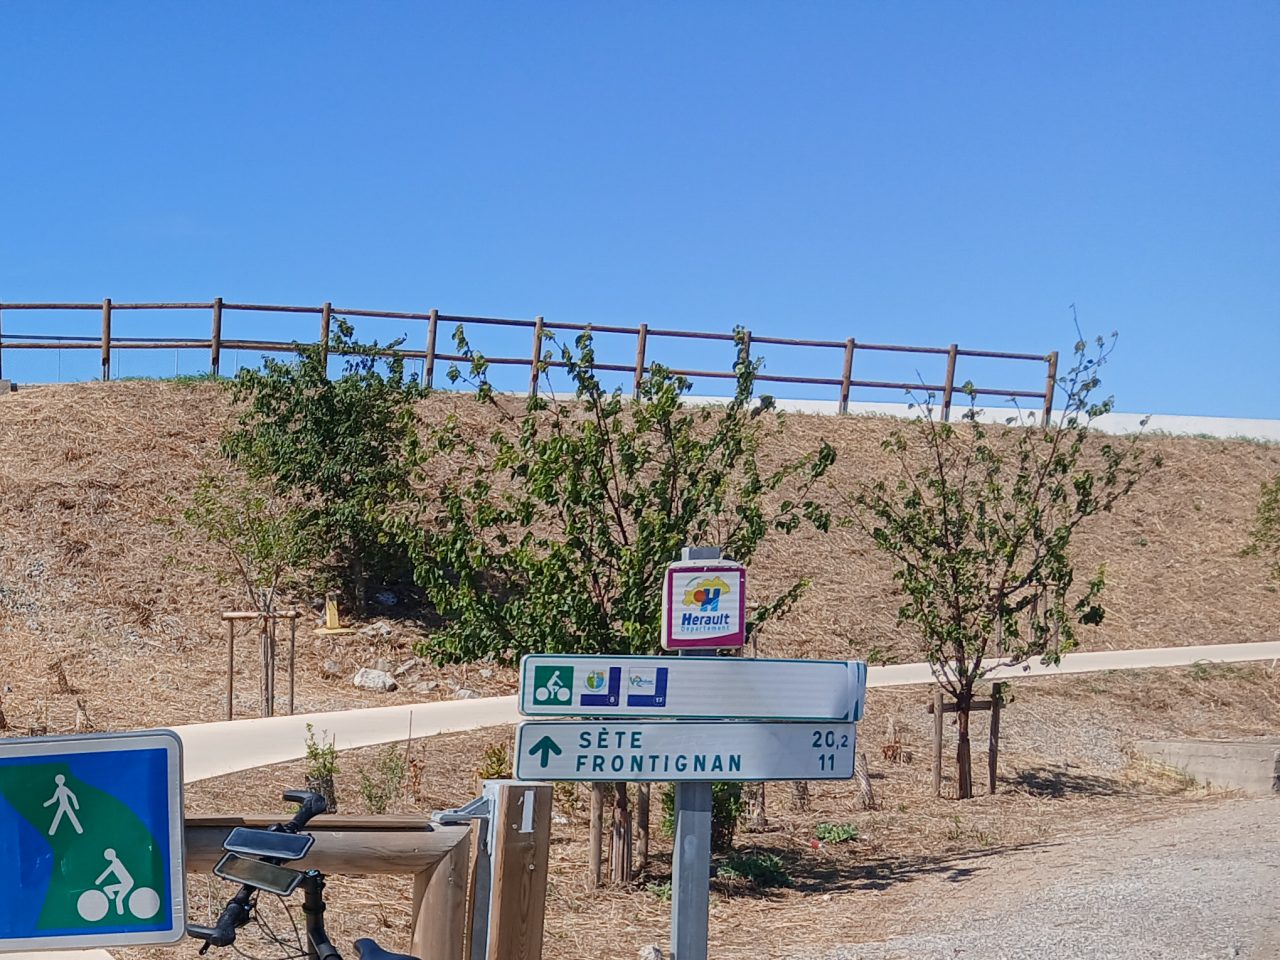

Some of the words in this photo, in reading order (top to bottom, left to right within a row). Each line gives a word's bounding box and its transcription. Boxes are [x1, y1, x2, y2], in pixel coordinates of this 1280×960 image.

[578, 727, 643, 749] SÈTE
[812, 730, 849, 750] 20,2
[575, 754, 742, 773] FRONTIGNAN
[818, 753, 835, 772] 11
